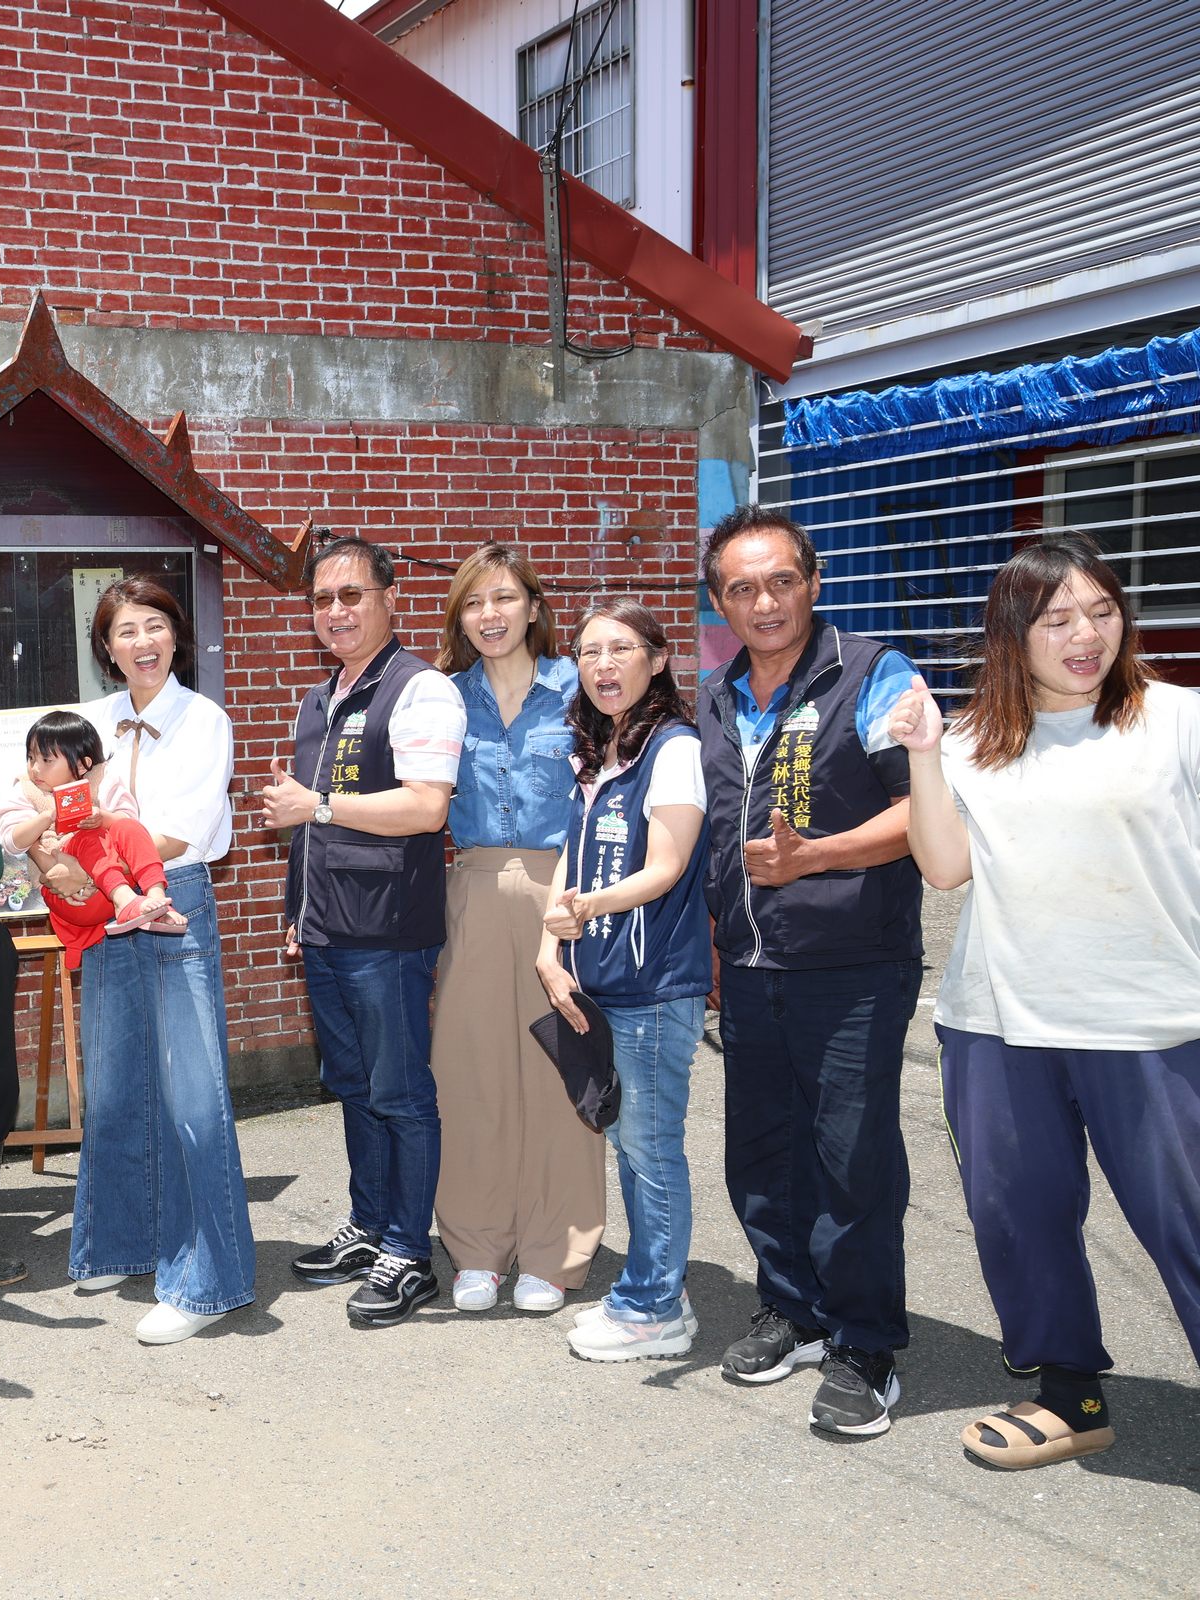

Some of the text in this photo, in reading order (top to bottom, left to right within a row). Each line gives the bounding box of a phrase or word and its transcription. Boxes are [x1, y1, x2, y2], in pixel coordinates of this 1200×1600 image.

[345, 738, 362, 795] 仁愛
[792, 731, 814, 828] 仁愛鄉民代表會
